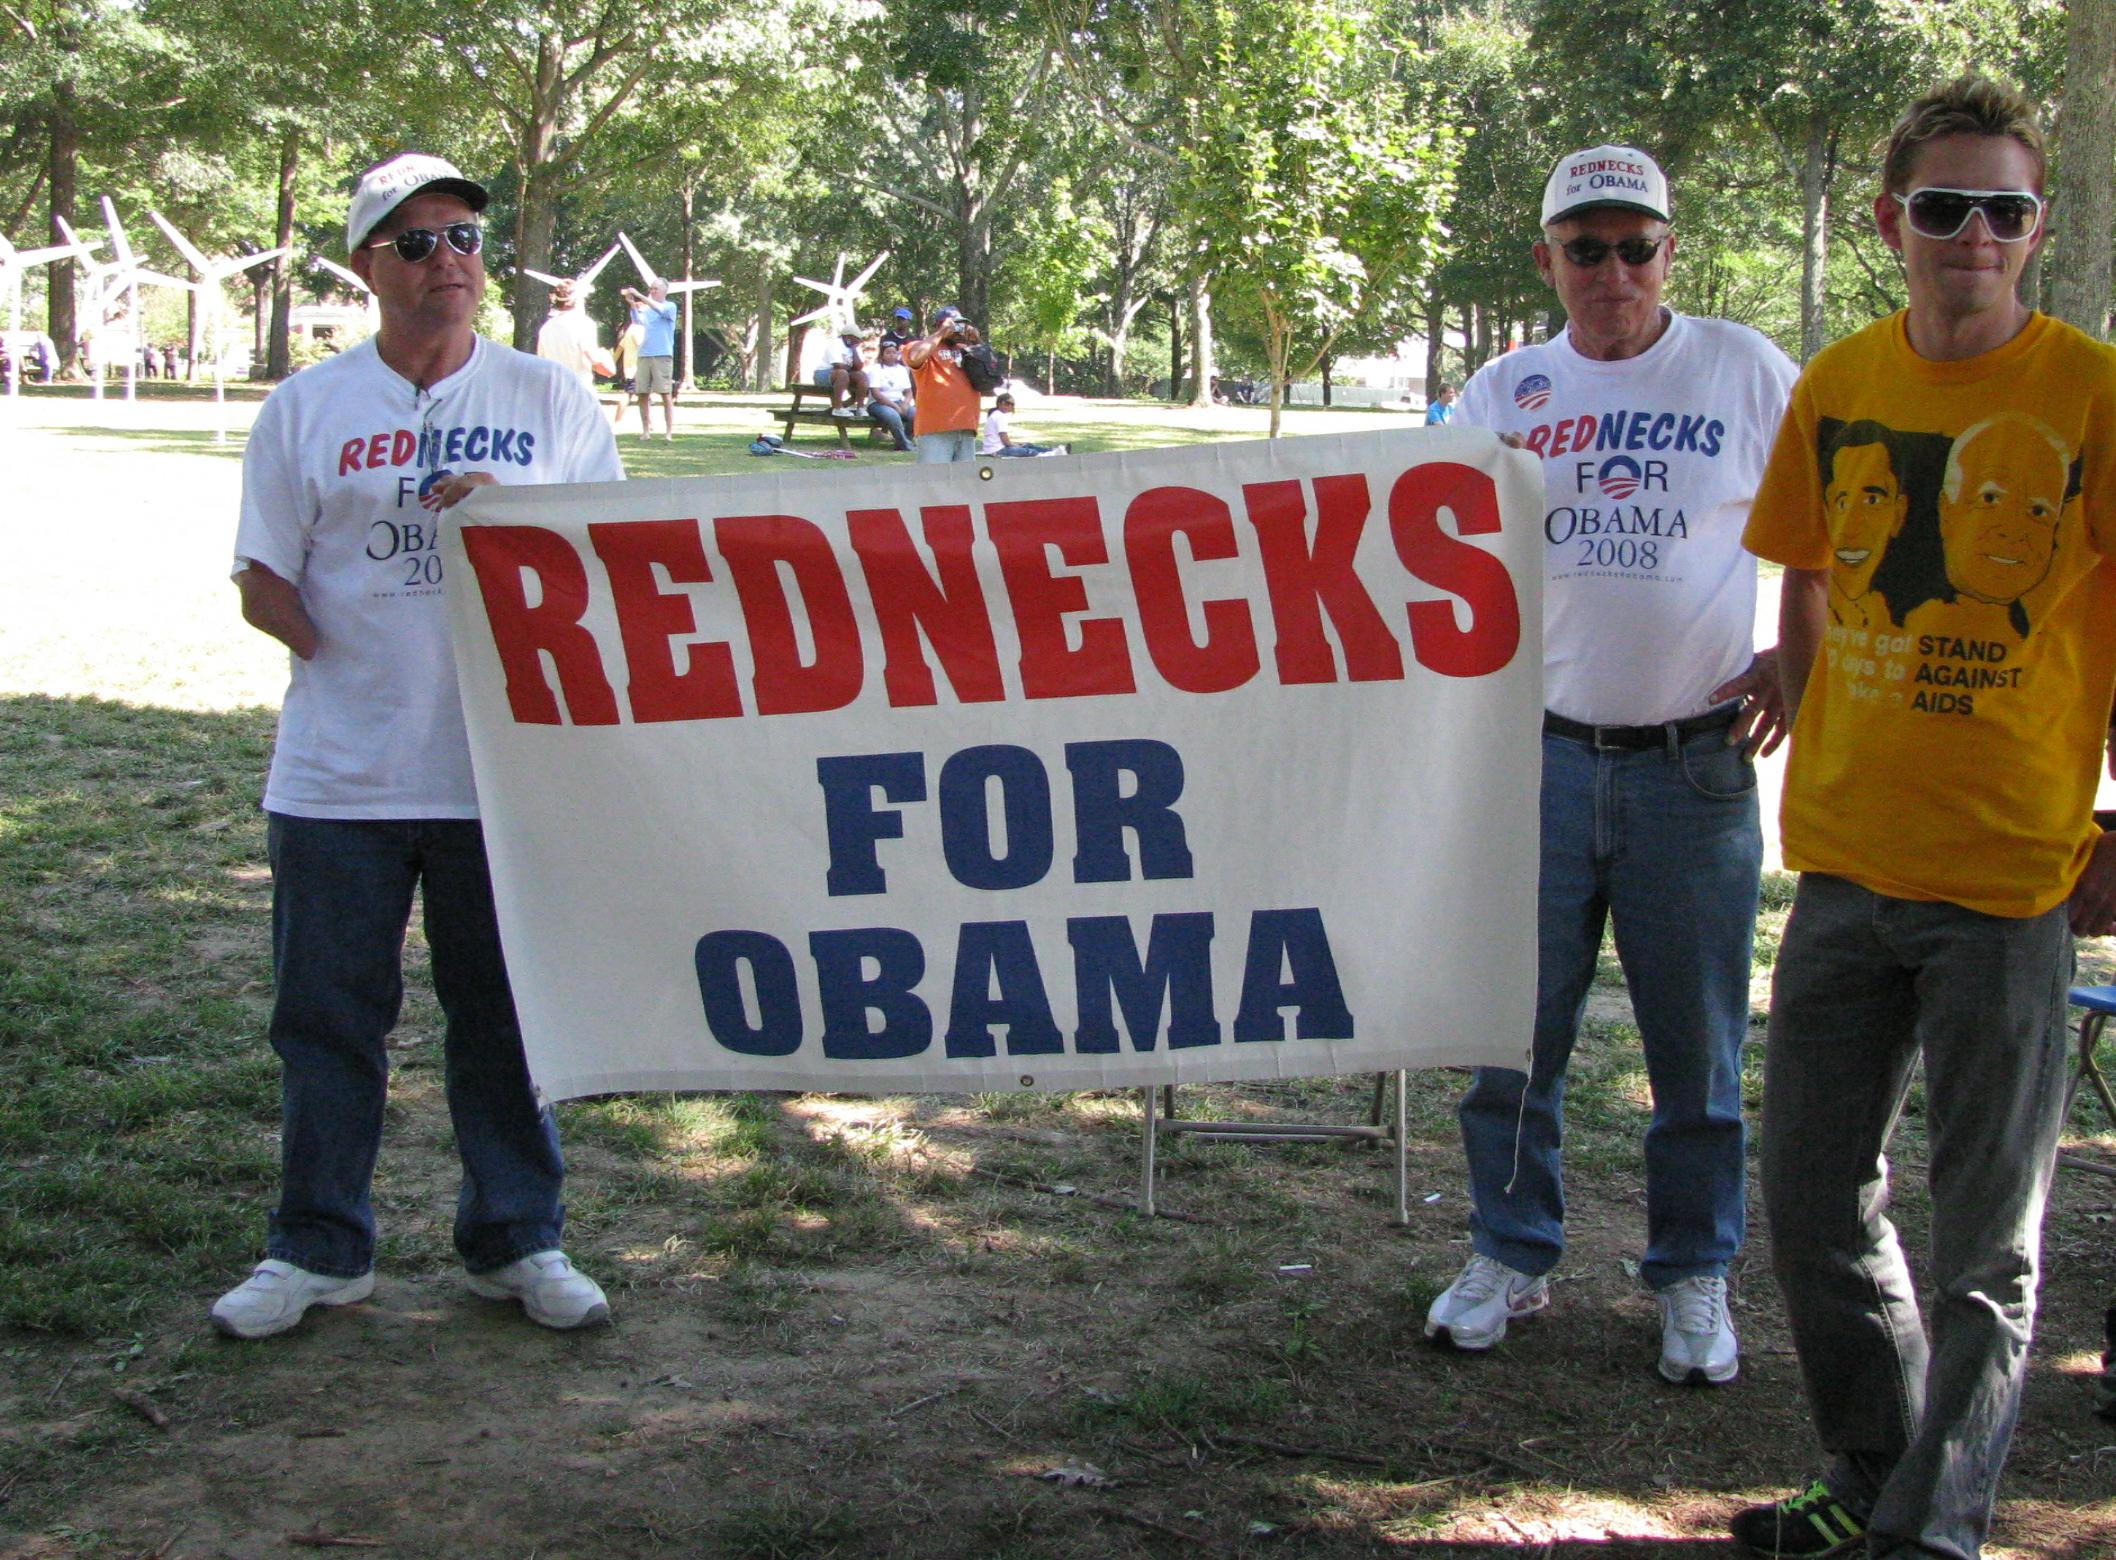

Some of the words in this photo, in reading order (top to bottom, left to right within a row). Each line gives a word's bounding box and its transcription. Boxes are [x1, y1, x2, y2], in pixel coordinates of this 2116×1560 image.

[1569, 160, 1644, 178] REDNECKS
[382, 187, 398, 201] for
[1566, 184, 1582, 196] for
[1589, 174, 1649, 193] OBAMA
[1526, 410, 1725, 460] REDNECKS
[338, 426, 536, 477] REDNECKS
[1576, 455, 1669, 500] FOR
[1544, 505, 1688, 545] OBAMA
[1577, 538, 1658, 569] 2008
[405, 555, 443, 586] 20
[461, 462, 1521, 727] REDNECKS
[1875, 633, 1913, 657] got
[1918, 635, 2008, 662] STAND
[1885, 659, 1906, 681] to
[1915, 663, 2023, 689] AGAINST
[1911, 690, 1974, 716] AIDS
[816, 738, 1194, 896] FOR
[694, 907, 1355, 1060] OBAMA
